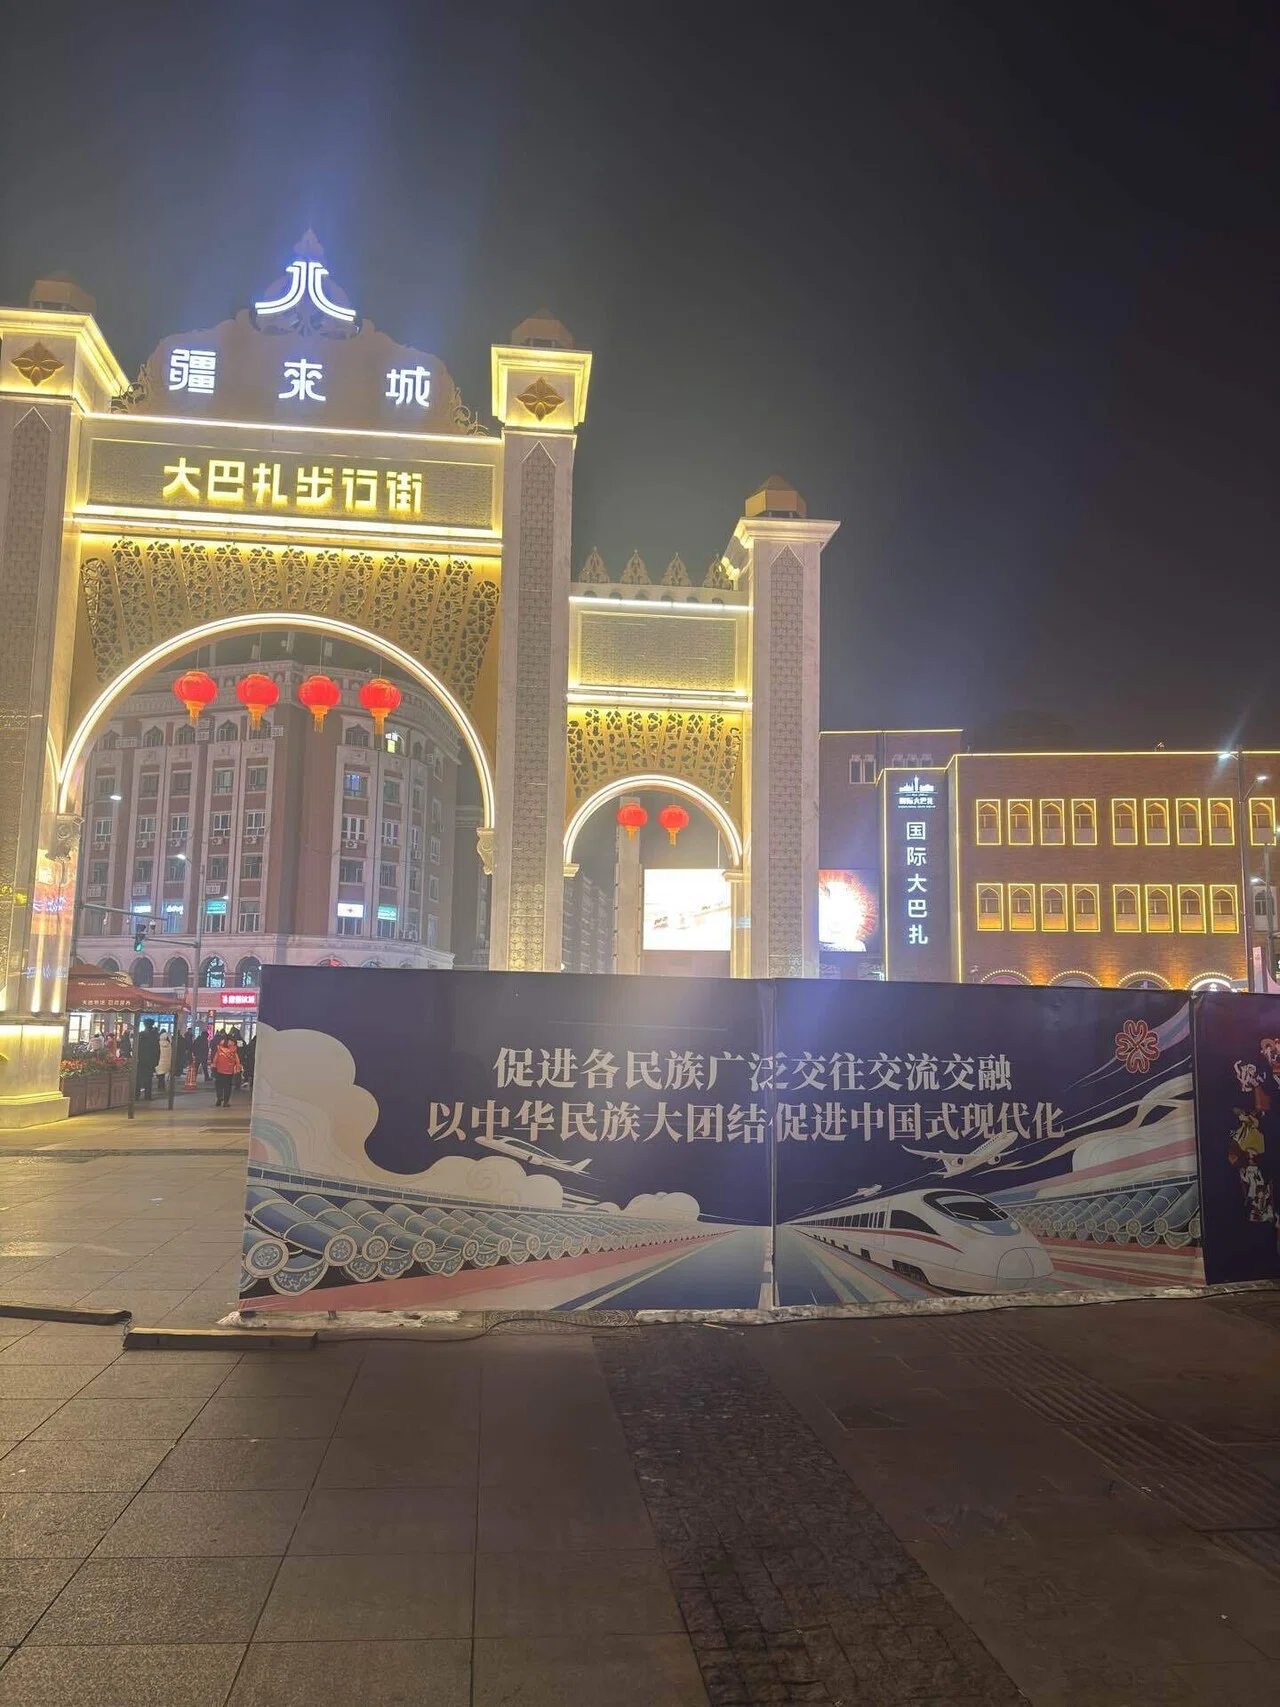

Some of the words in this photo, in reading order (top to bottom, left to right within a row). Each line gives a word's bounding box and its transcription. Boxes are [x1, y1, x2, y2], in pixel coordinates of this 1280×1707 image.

[162, 457, 423, 513] 大巴扎步行街
[906, 821, 929, 945] 国际大巴扎
[493, 1046, 1013, 1092] 促进各民族广泛交往交流交融
[426, 1099, 1066, 1144] 以中华民族大团结促进中国式现代化
